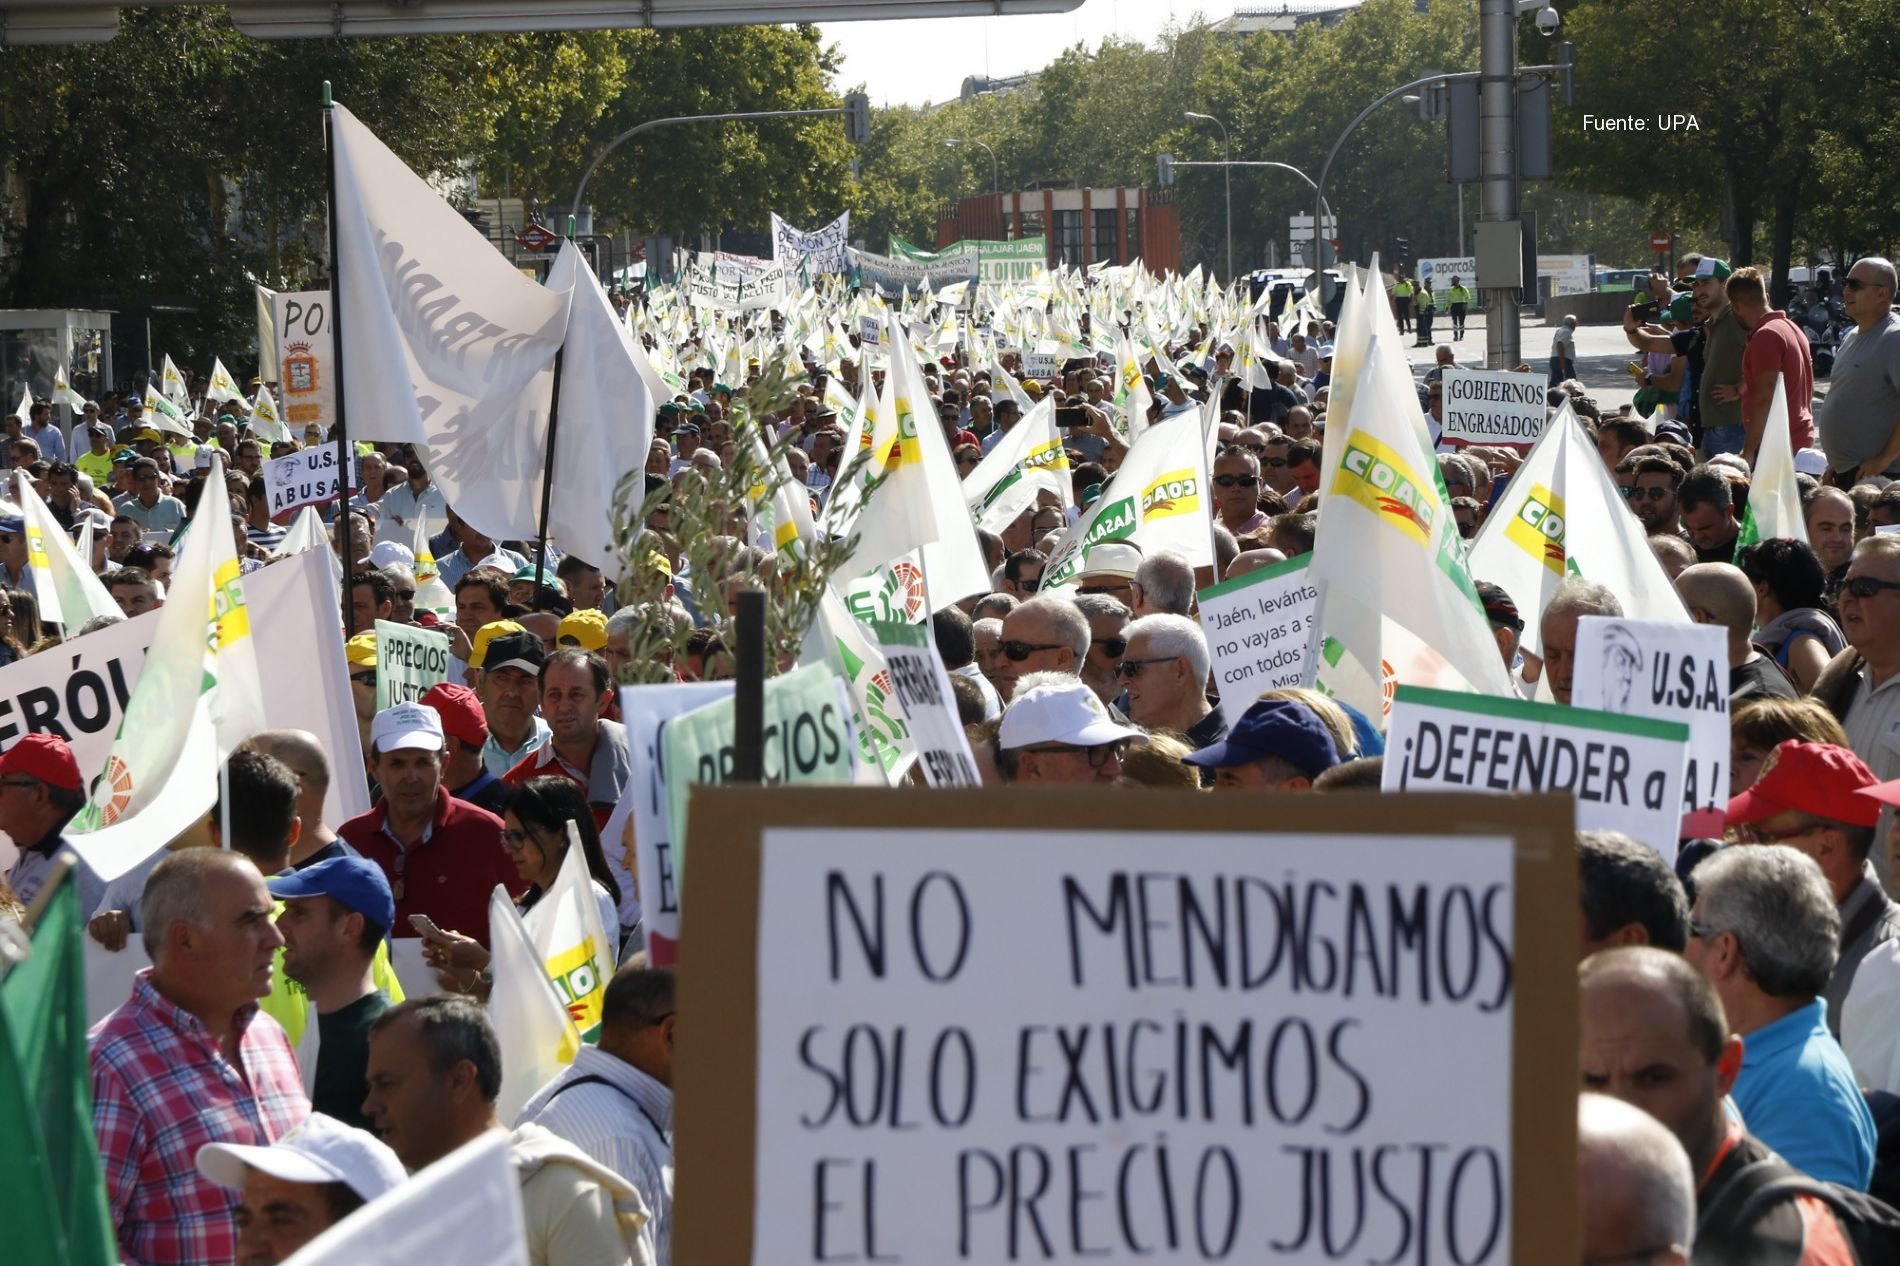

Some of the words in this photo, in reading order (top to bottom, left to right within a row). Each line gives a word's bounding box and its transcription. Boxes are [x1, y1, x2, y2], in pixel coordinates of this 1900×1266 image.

[284, 299, 330, 338] PO
[1448, 379, 1543, 405] ¡GOBIERNOS
[1448, 411, 1543, 438] ENGRASADOS!
[308, 451, 351, 470] U.S..
[1522, 499, 1564, 546] CO
[1208, 606, 1246, 631] "Jaén,
[384, 638, 448, 674] ¡PRECIOS
[1216, 641, 1239, 658] no
[1242, 624, 1288, 649] vayas
[1292, 619, 1302, 633] a
[1225, 665, 1254, 684] con
[1256, 648, 1301, 673] todos
[1652, 650, 1726, 713] U.S.A.
[1400, 720, 1630, 806] ¡DEFENDER
[1643, 769, 1666, 811] a
[826, 869, 973, 985] NO
[1061, 867, 1514, 1013] MENDIGAMOS
[799, 1020, 978, 1131] SOLO
[1014, 1008, 1371, 1136] EXIGIMOS
[812, 1156, 902, 1263] EL
[957, 1131, 1243, 1263] PRECIO
[1269, 1141, 1504, 1266] JUSTO
